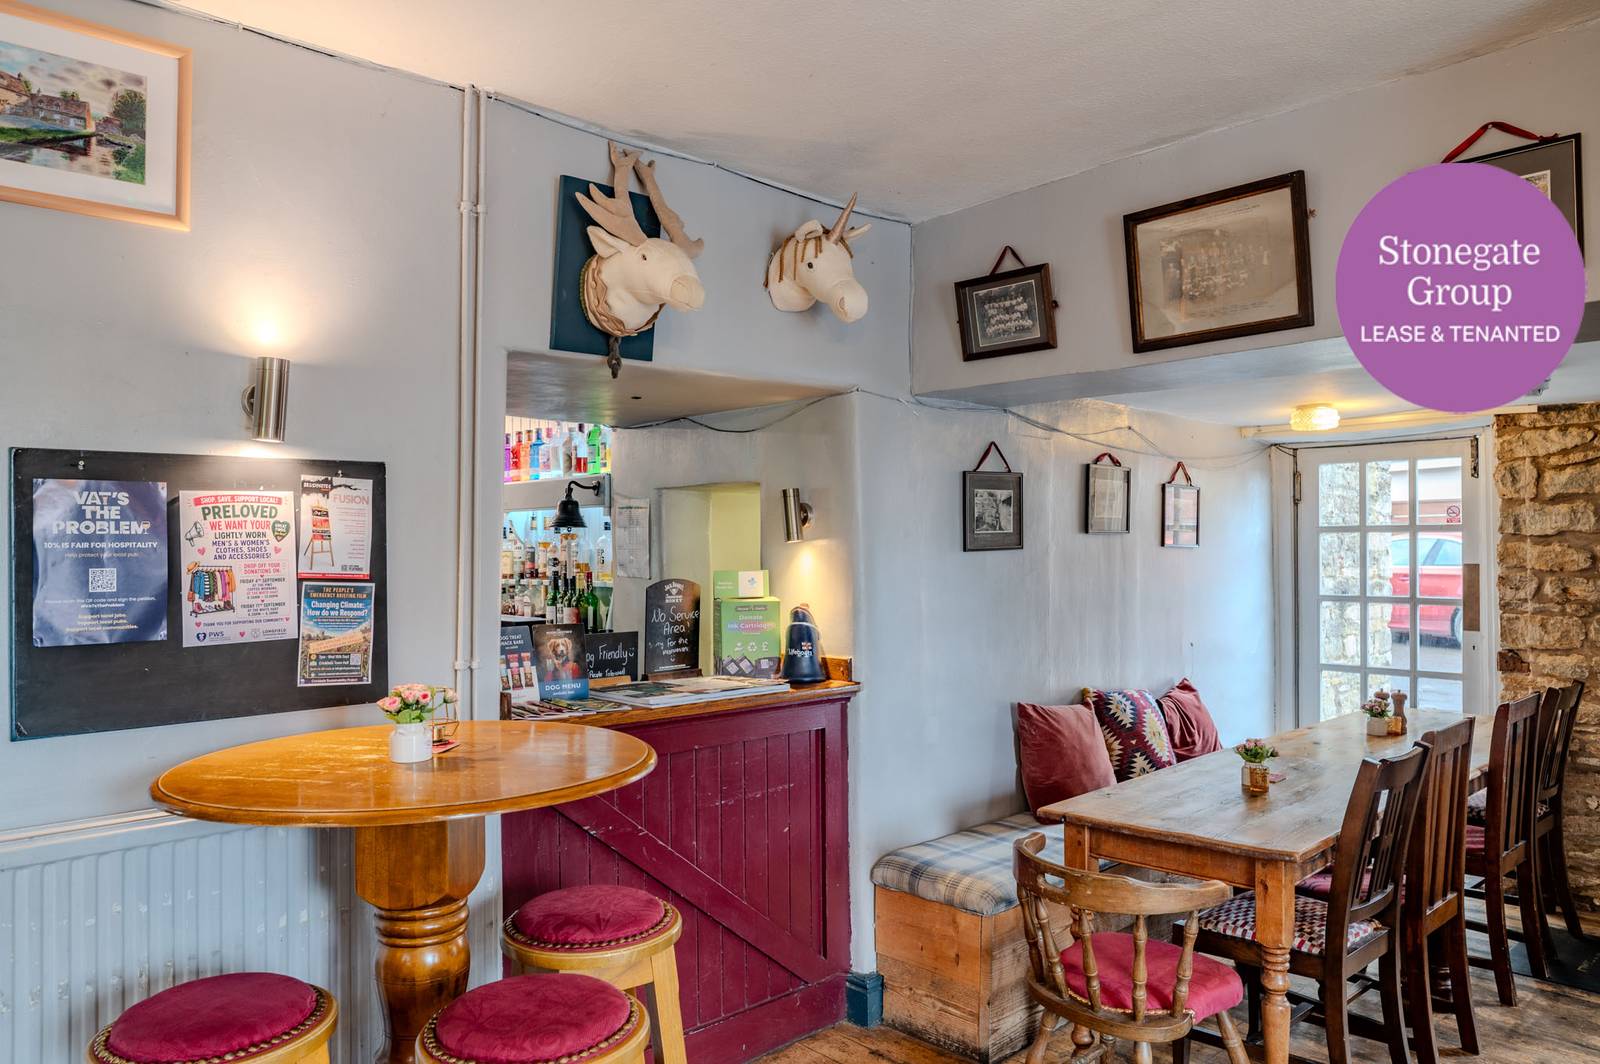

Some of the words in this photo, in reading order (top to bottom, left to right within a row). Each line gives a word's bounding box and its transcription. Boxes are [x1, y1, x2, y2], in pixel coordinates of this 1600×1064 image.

[74, 491, 130, 506] VAT'S
[234, 495, 258, 503] SUPPORT
[333, 494, 369, 505] FUSION
[82, 506, 120, 520] THE
[201, 504, 278, 520] PRELOVED
[52, 520, 148, 535] PROBLEM
[209, 520, 222, 531] WE
[224, 520, 248, 530] WANT
[249, 520, 271, 530] YOUR
[214, 532, 243, 540] LIGHTLY
[107, 541, 158, 549] HOSPITALITY
[228, 552, 272, 560] ACCESSORIES!
[311, 600, 340, 609] Changing
[340, 609, 368, 617] Respond?
[651, 608, 666, 623] No
[667, 637, 676, 647] for
[598, 642, 628, 666] Friendly
